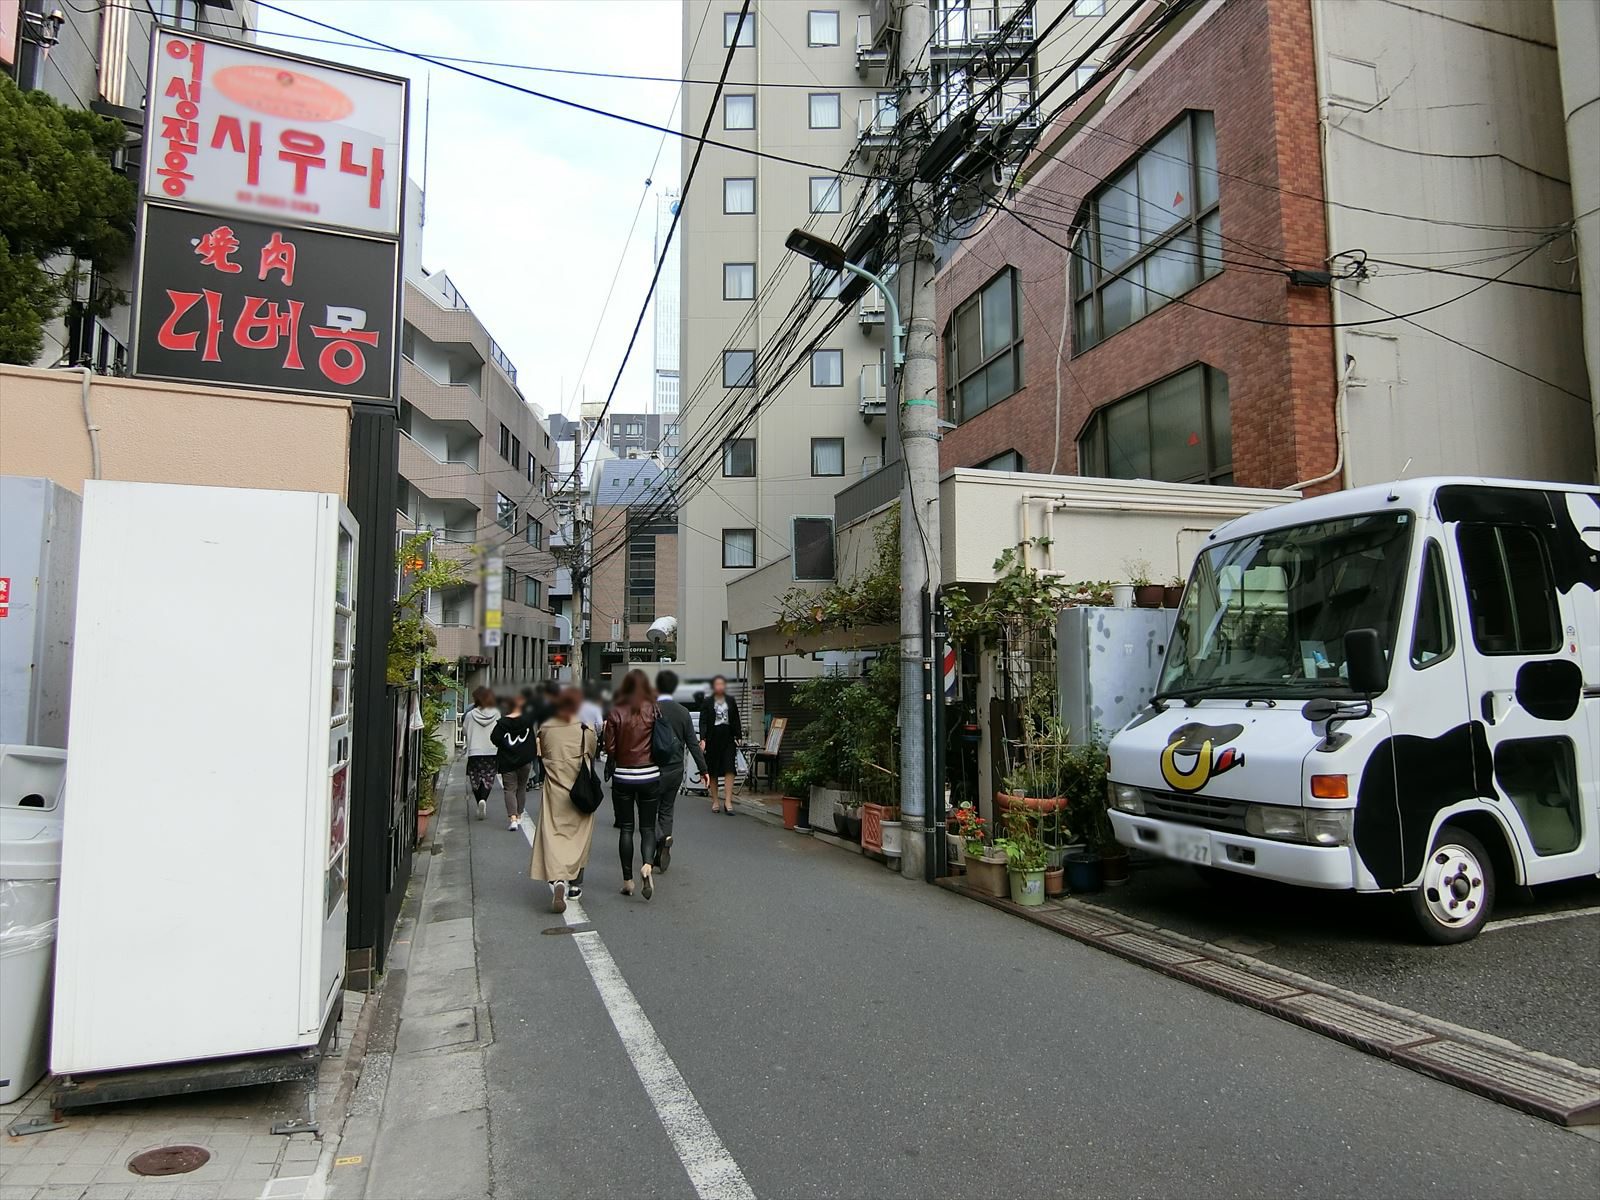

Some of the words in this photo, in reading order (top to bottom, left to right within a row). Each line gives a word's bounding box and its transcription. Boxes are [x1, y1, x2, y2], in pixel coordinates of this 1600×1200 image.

[157, 40, 204, 197] 여성전용
[211, 114, 385, 209] 사우나
[157, 288, 380, 385] 다베몽
